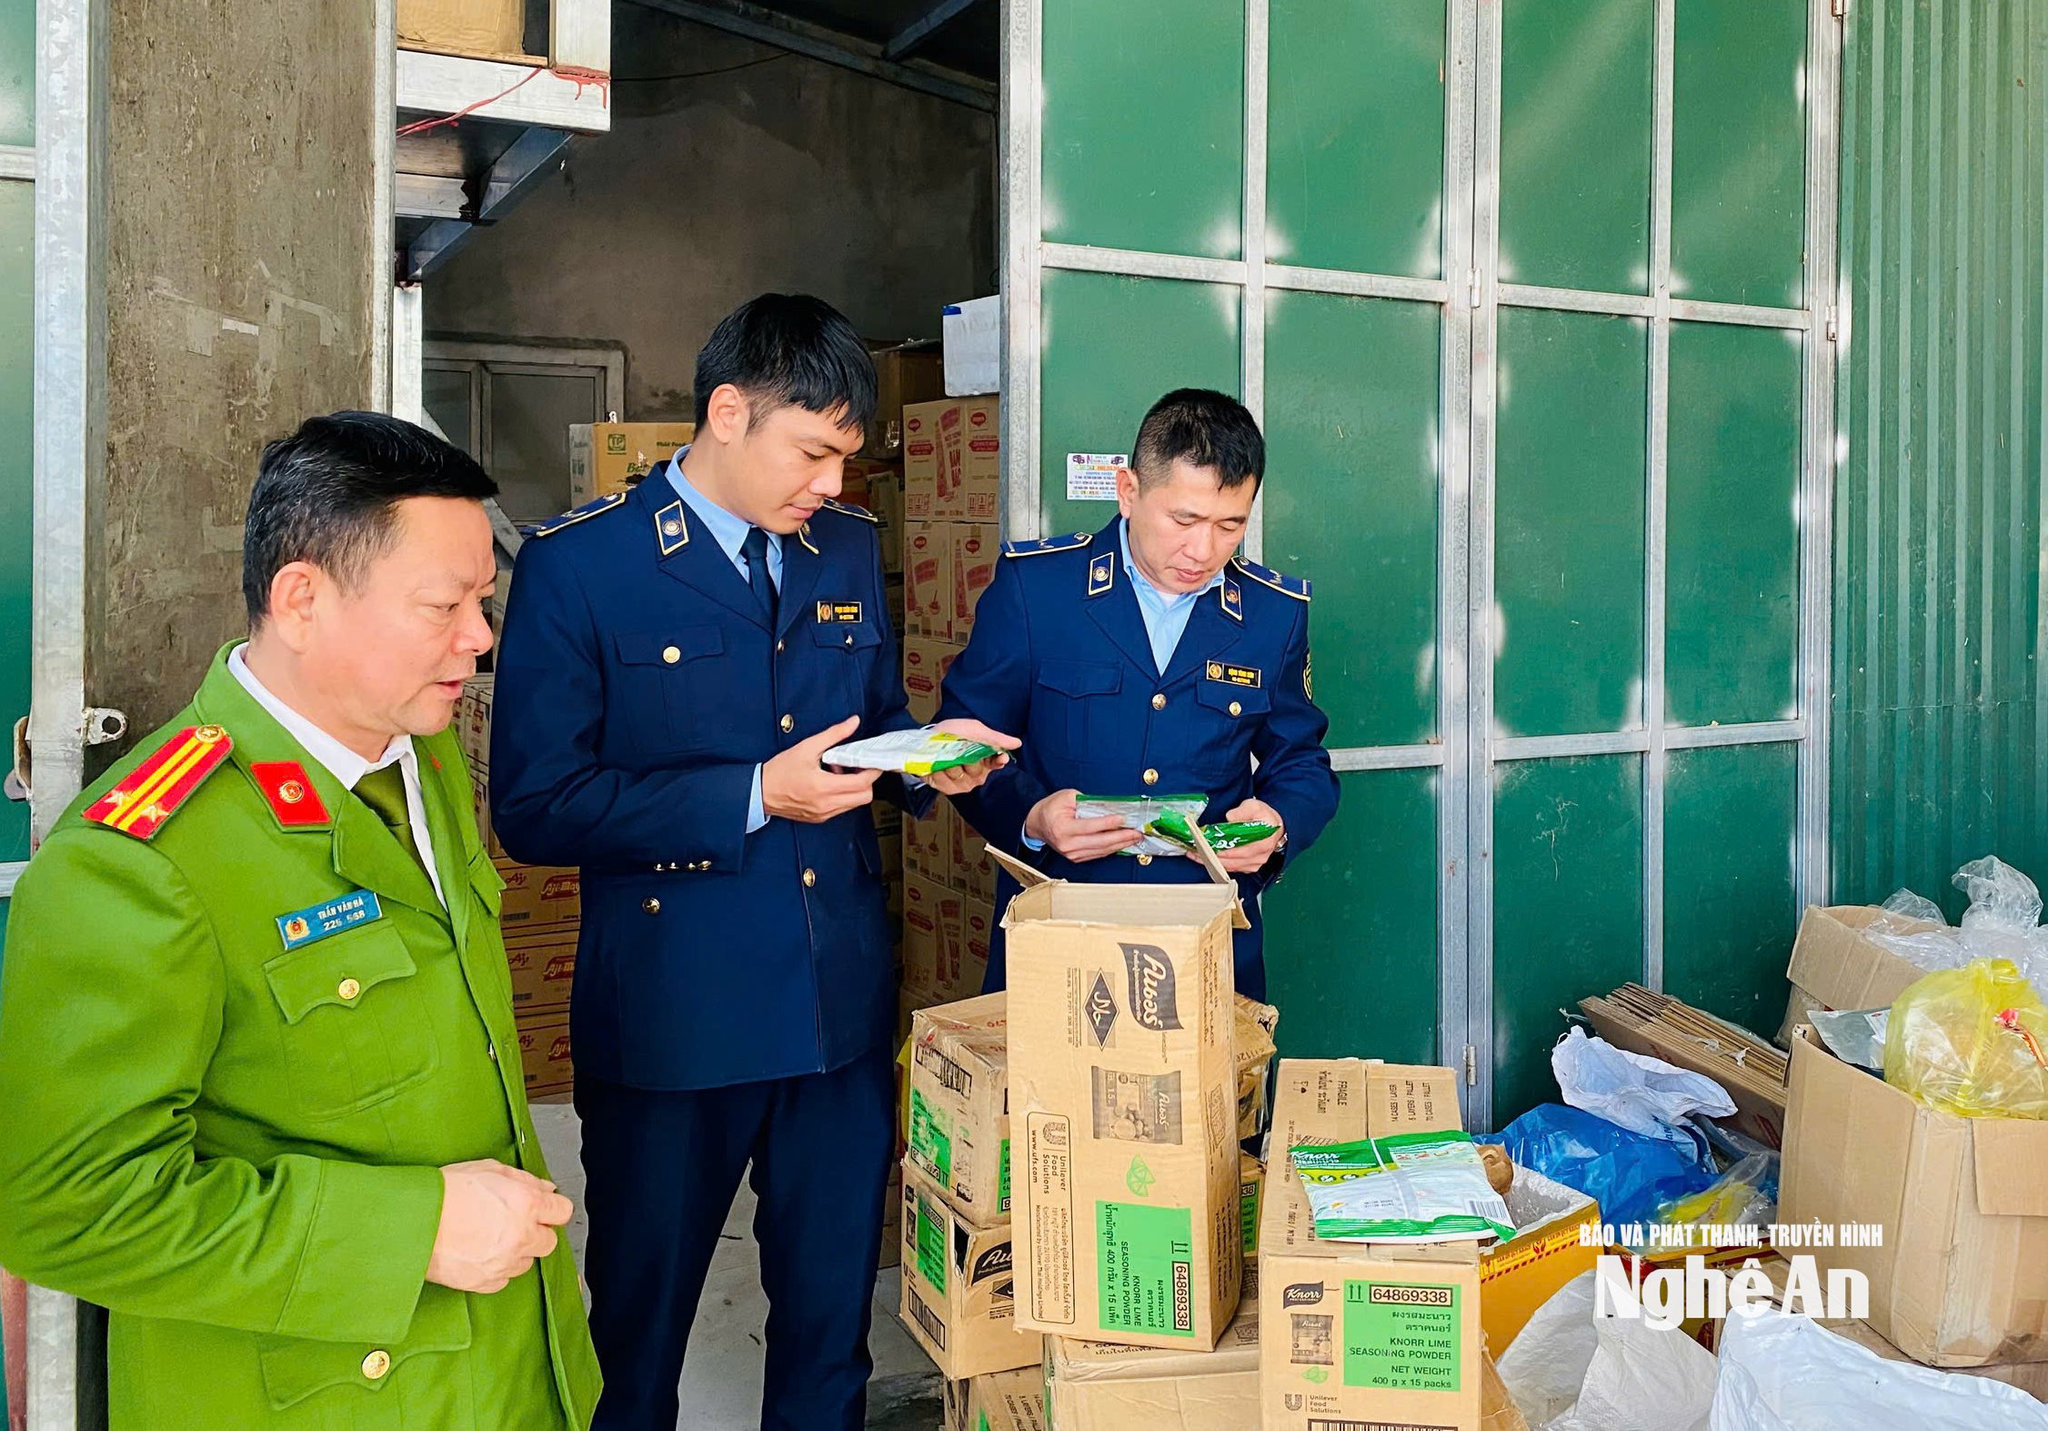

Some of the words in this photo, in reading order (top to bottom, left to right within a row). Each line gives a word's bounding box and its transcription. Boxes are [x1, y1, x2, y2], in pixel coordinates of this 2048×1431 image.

[1337, 1081, 1347, 1106] FRAGILE
[1031, 1130, 1039, 1183] www.ufs.com
[1107, 1249, 1115, 1264] 400
[1121, 1241, 1129, 1287] SEASONING
[1133, 1275, 1141, 1304] KNORR
[1176, 1265, 1188, 1327] 64869338
[1287, 1289, 1321, 1299] Knorr
[1373, 1289, 1448, 1303] 64869338
[1108, 1293, 1116, 1303] 15
[1390, 1338, 1424, 1347] KNORR
[1428, 1339, 1451, 1348] LIME
[1349, 1348, 1405, 1358] SEASONING
[1409, 1352, 1451, 1360] POWDER
[1414, 1367, 1452, 1375] WEIGHT
[1372, 1377, 1388, 1385] 400
[1391, 1379, 1398, 1387] g
[1410, 1379, 1421, 1387] 15
[1424, 1380, 1451, 1388] packs
